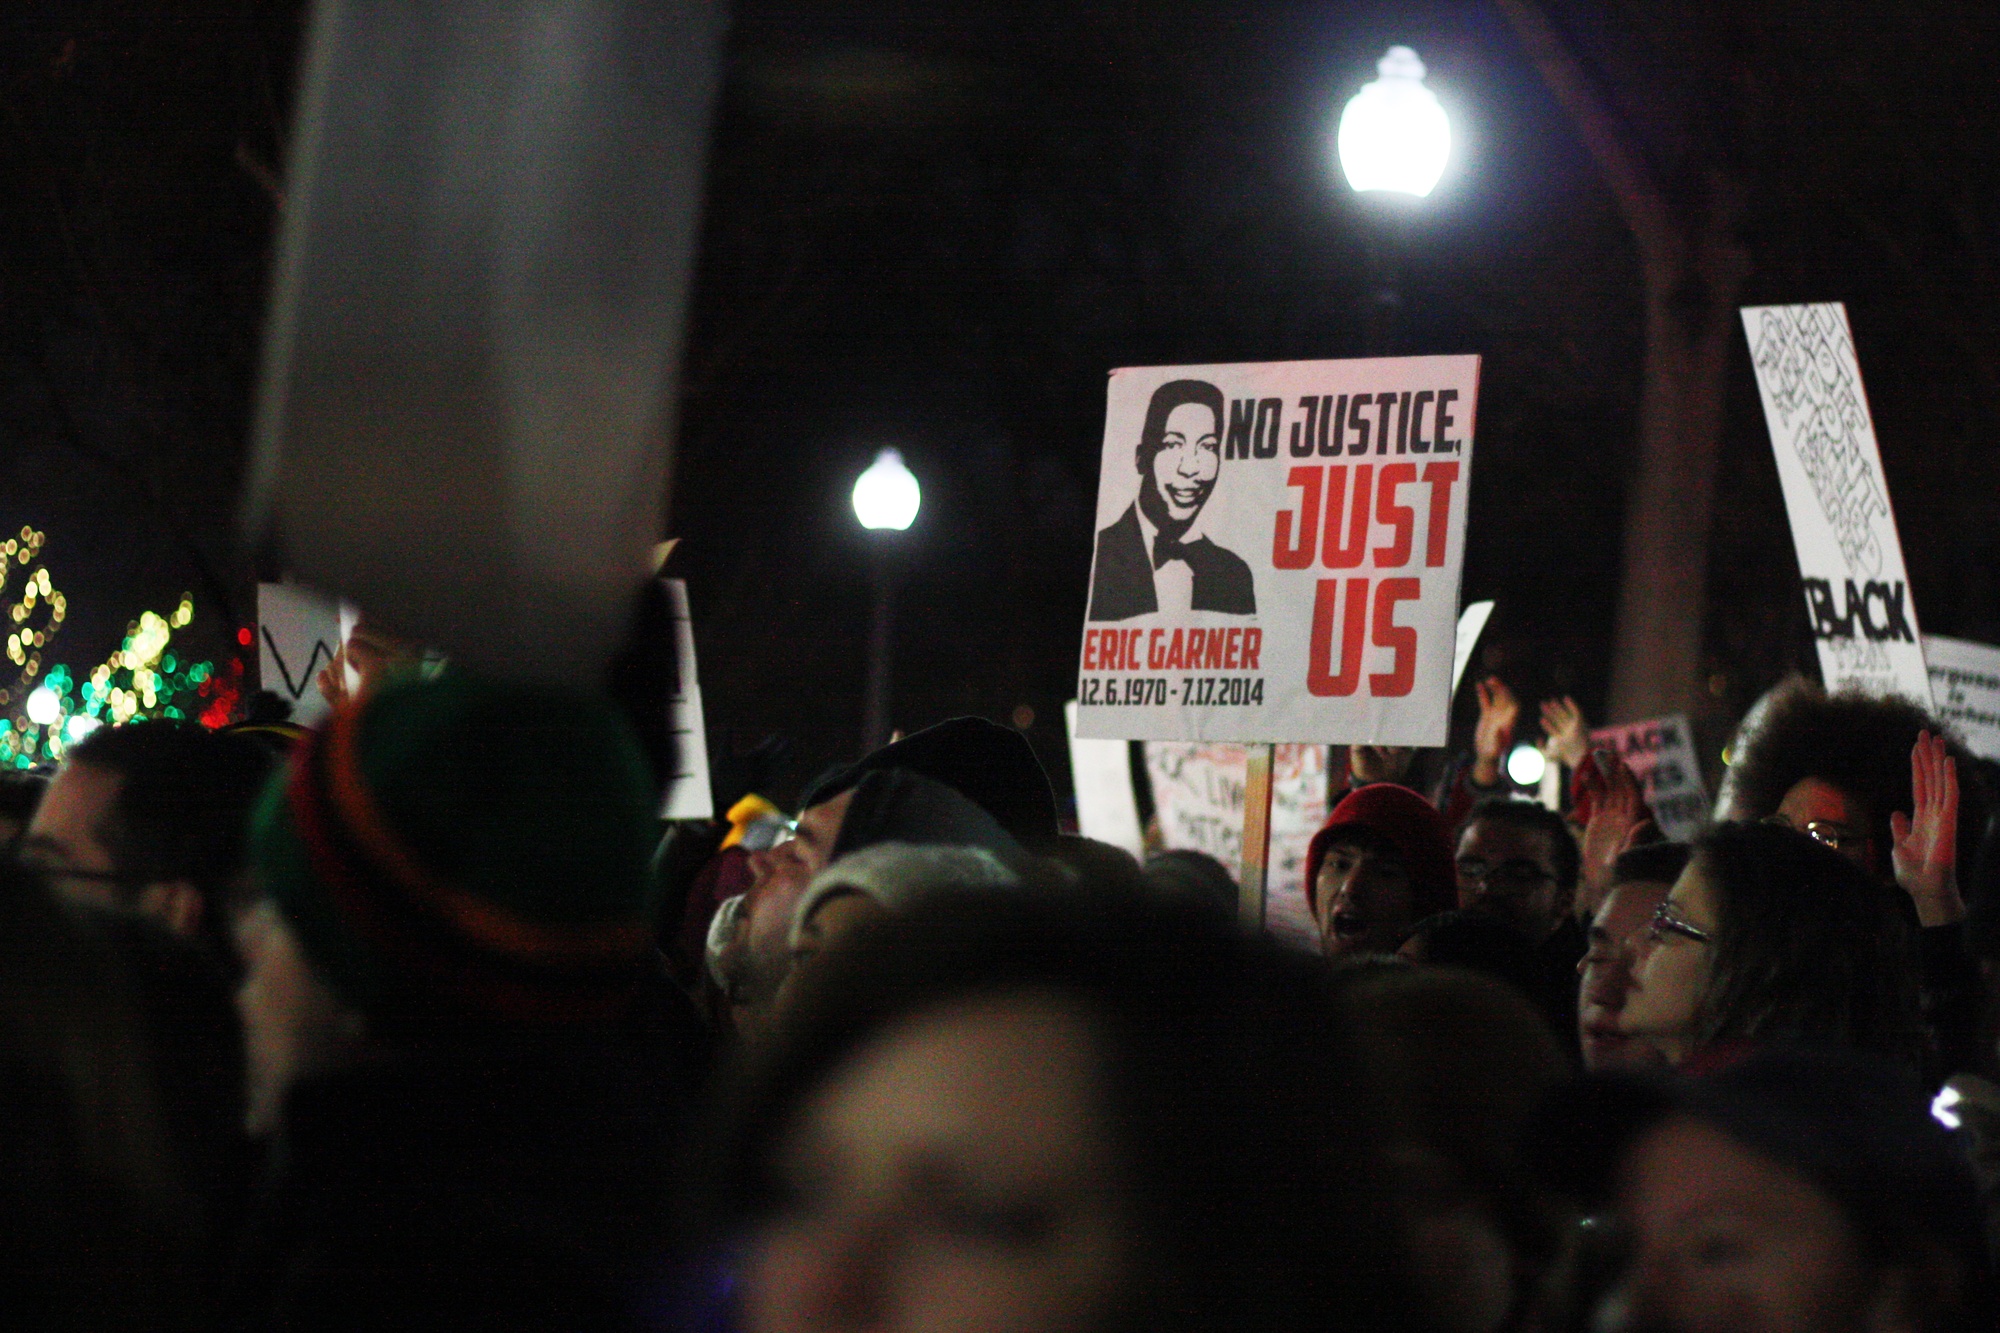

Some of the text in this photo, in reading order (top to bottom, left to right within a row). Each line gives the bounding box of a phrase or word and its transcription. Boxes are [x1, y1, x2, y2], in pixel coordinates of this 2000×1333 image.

[1225, 389, 1461, 460] NO JUSTICE,
[1272, 461, 1460, 570] JUST
[1306, 577, 1420, 698] US
[1803, 578, 1915, 643] BLACK
[1083, 627, 1262, 670] ERIC GARNER
[1081, 678, 1167, 706] 12.6.1970
[1181, 677, 1264, 706] 7.17.2014
